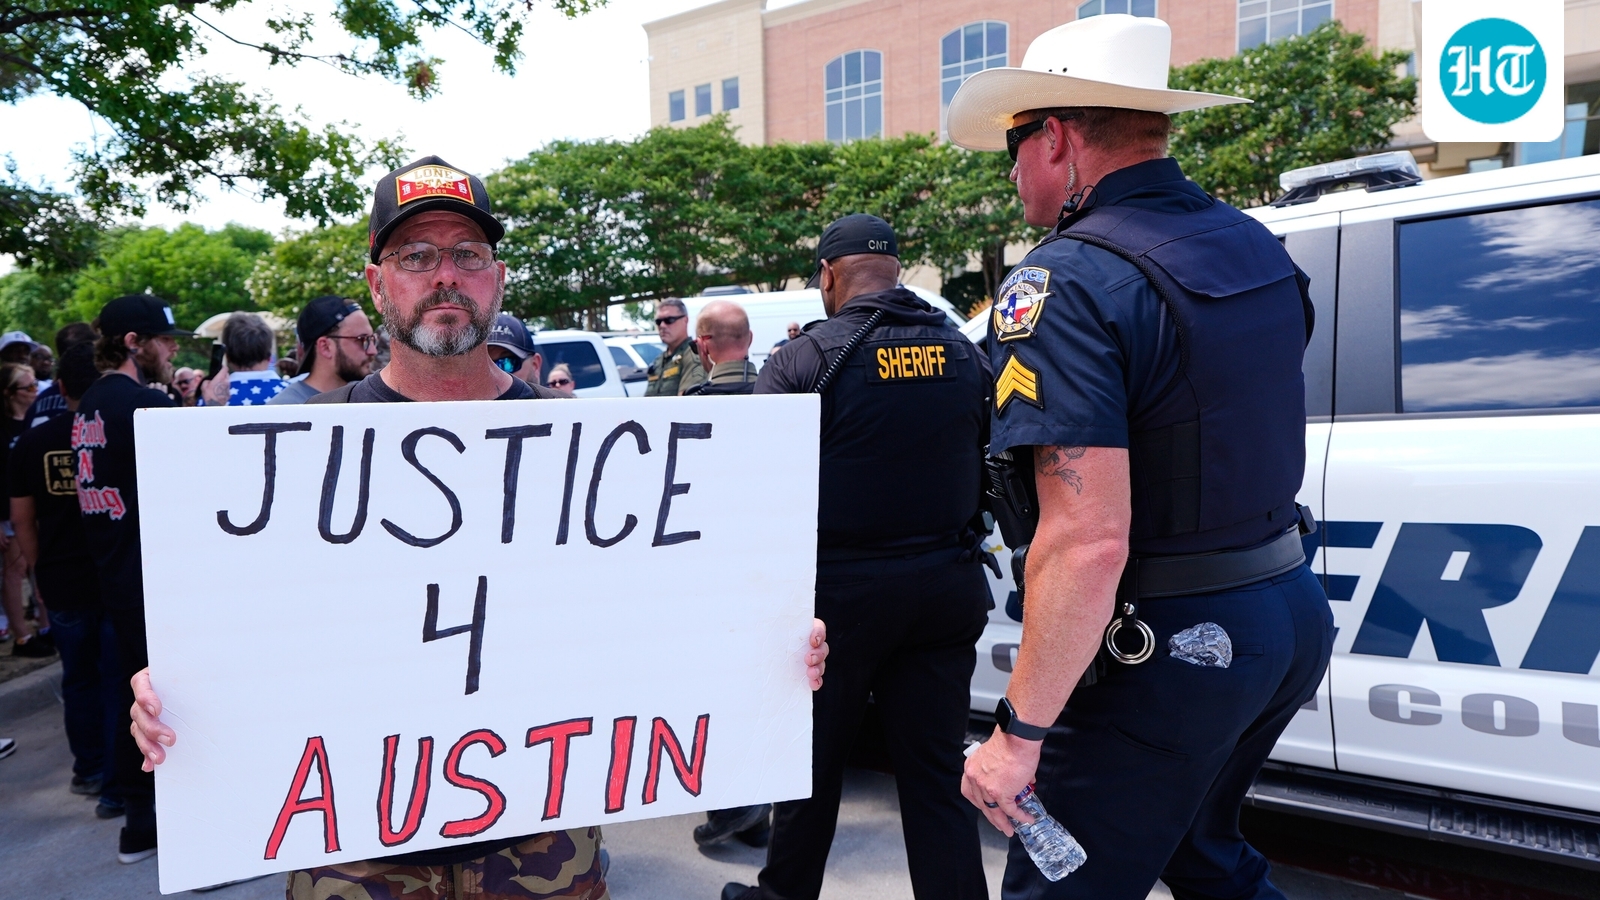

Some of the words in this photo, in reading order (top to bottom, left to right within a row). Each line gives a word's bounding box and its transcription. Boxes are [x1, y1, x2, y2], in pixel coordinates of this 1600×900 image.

[413, 168, 454, 180] LONE
[415, 178, 456, 190] STAR
[868, 239, 889, 251] CNT
[1001, 269, 1047, 293] POLICE
[876, 345, 946, 380] SHERIFF
[217, 420, 713, 549] JUSTICE
[422, 575, 488, 696] 4
[263, 713, 710, 861] AUSTIN
